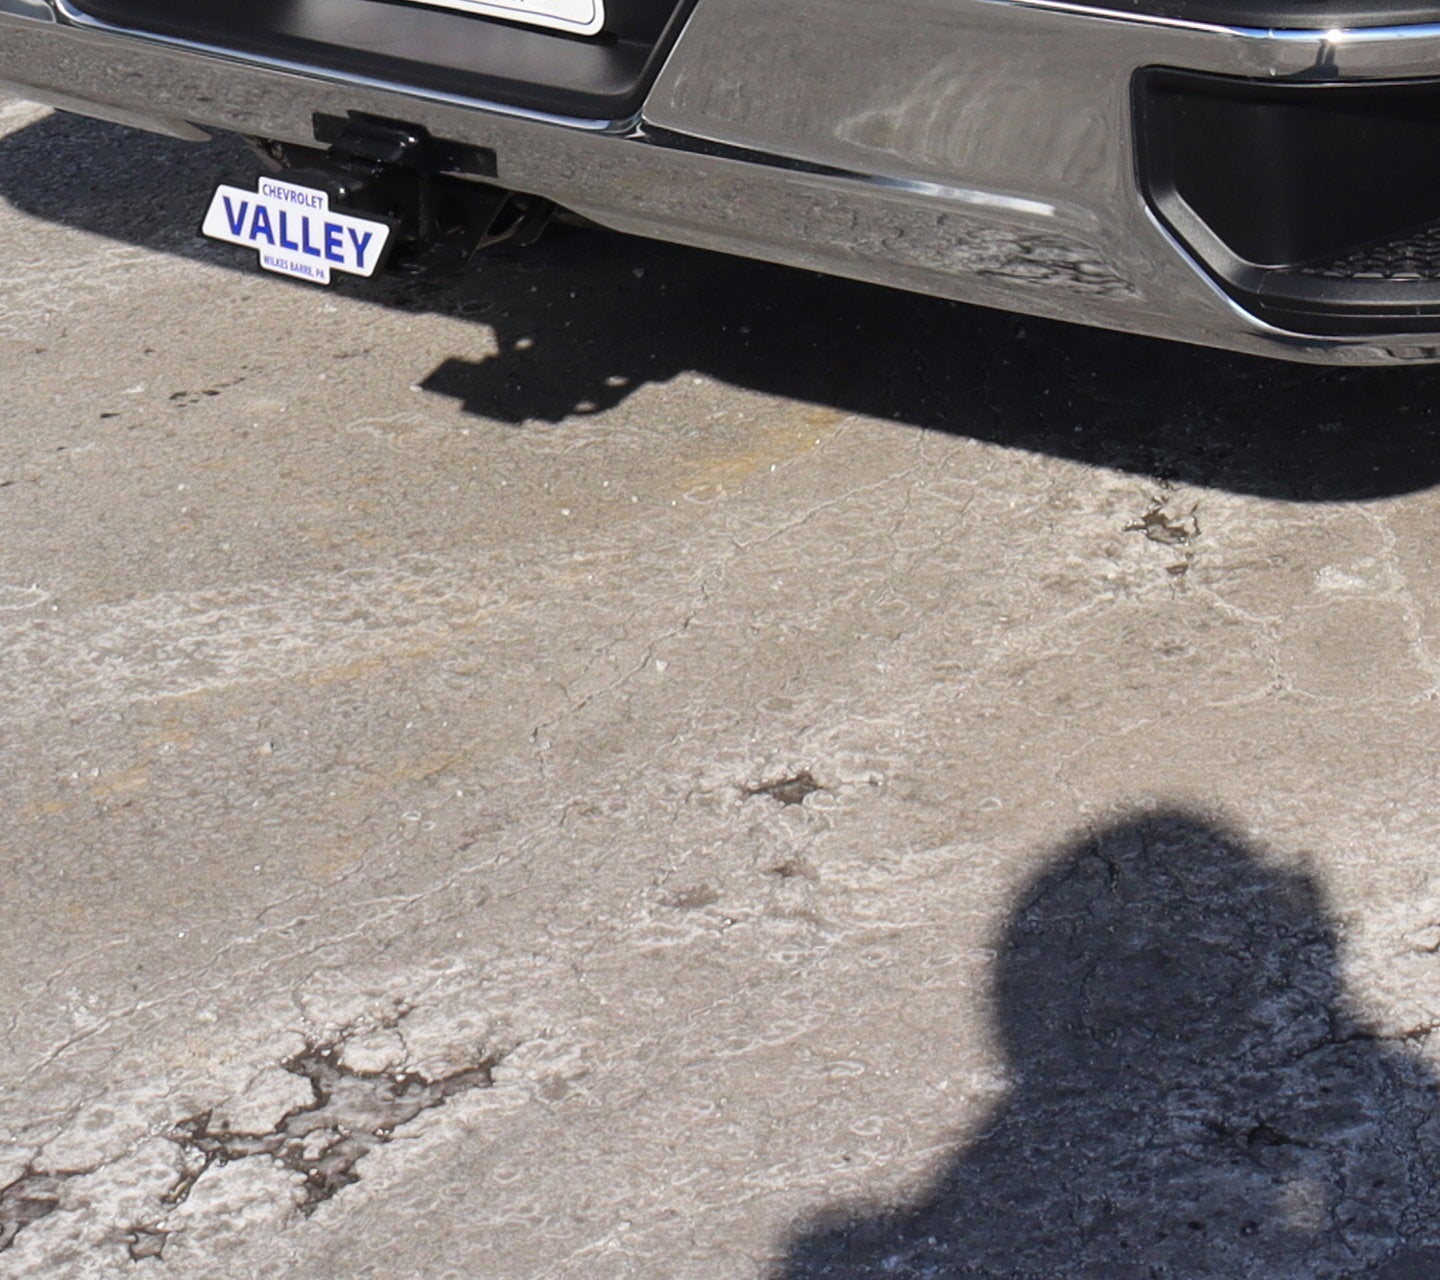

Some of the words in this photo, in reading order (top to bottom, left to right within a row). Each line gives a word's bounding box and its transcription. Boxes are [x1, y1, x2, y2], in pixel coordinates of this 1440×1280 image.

[262, 183, 324, 210] CHEVROLET
[222, 195, 373, 269] VALLEY
[263, 254, 289, 270] WILKES
